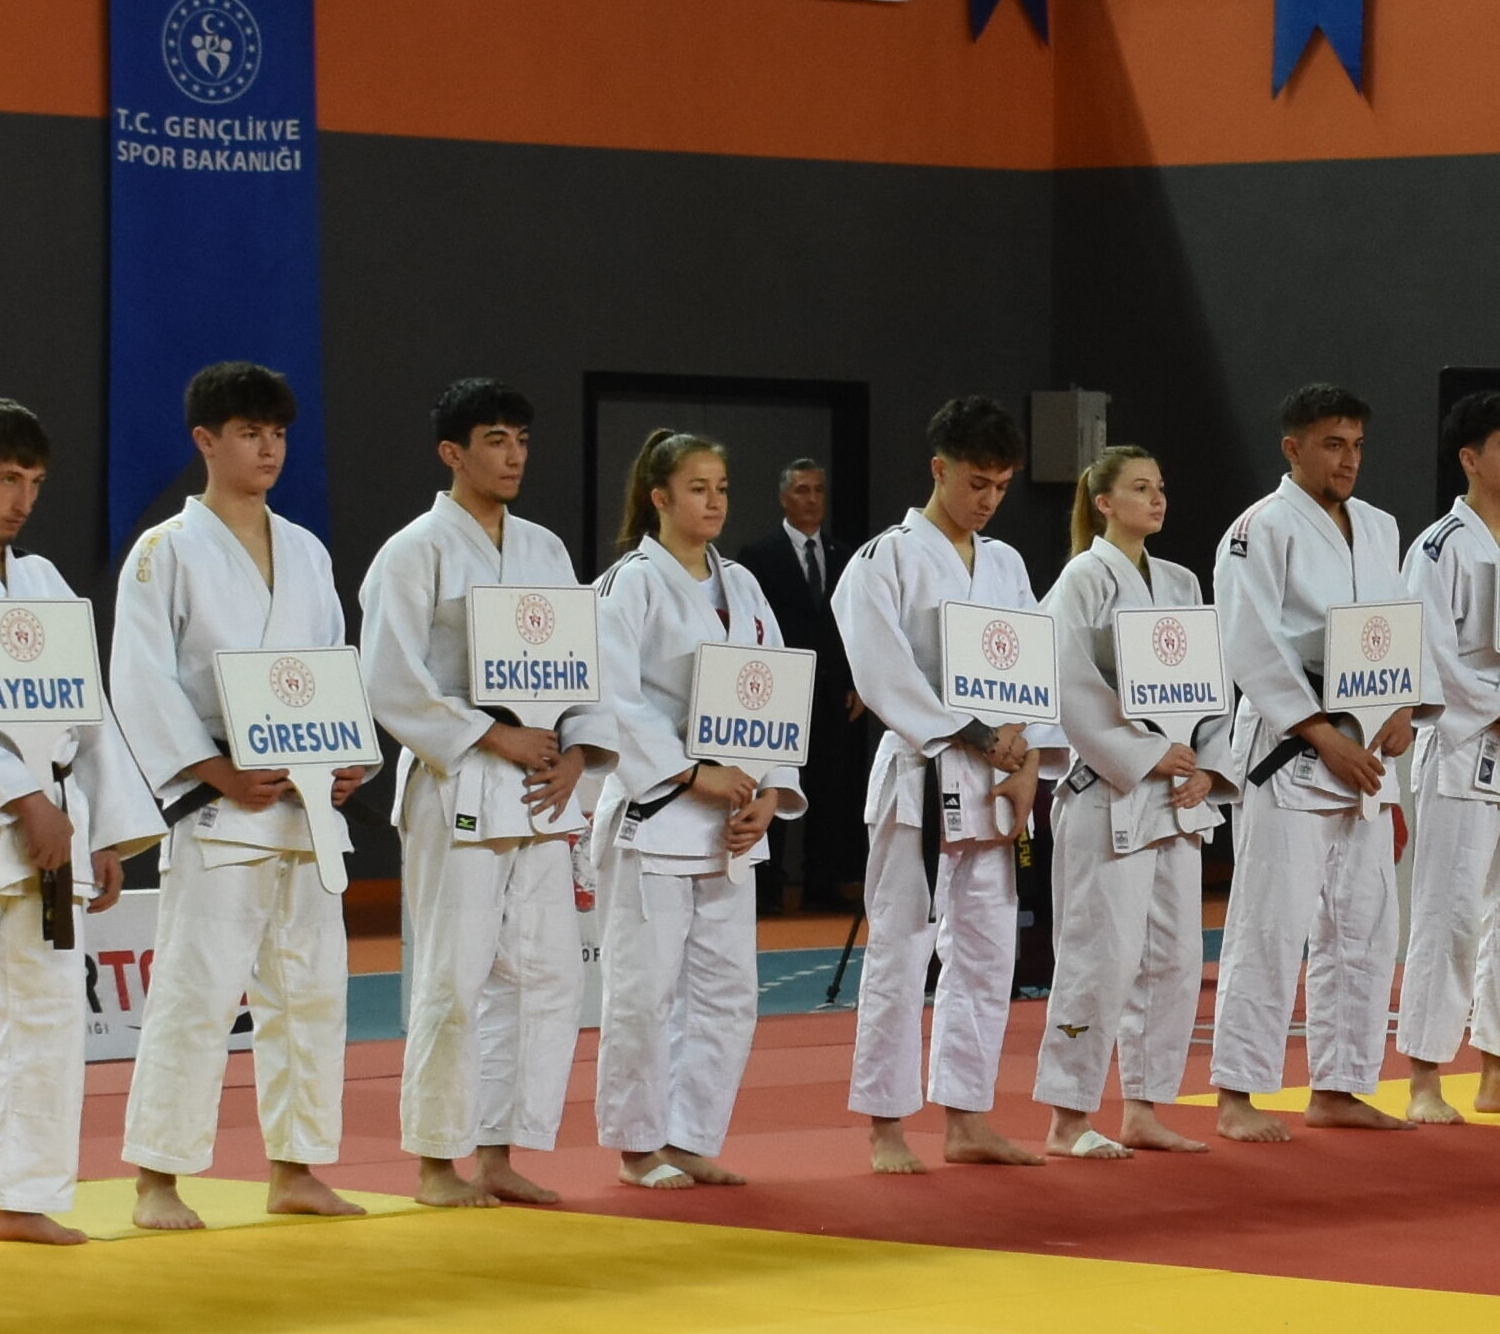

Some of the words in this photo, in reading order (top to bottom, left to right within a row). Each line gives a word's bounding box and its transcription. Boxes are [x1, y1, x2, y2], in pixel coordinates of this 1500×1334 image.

[116, 108, 157, 135] T.C.
[164, 116, 267, 146] GENÇLİK
[271, 119, 300, 141] VE
[117, 140, 176, 168] SPOR
[182, 146, 301, 172] BAKANLIĞI
[485, 651, 589, 698] ESKİŞEHİR
[1337, 668, 1412, 699] AMASYA
[954, 676, 1048, 707] BATMAN
[1131, 680, 1218, 705] İSTANBUL
[248, 714, 362, 754] GİRESUN
[699, 716, 799, 751] BURDUR
